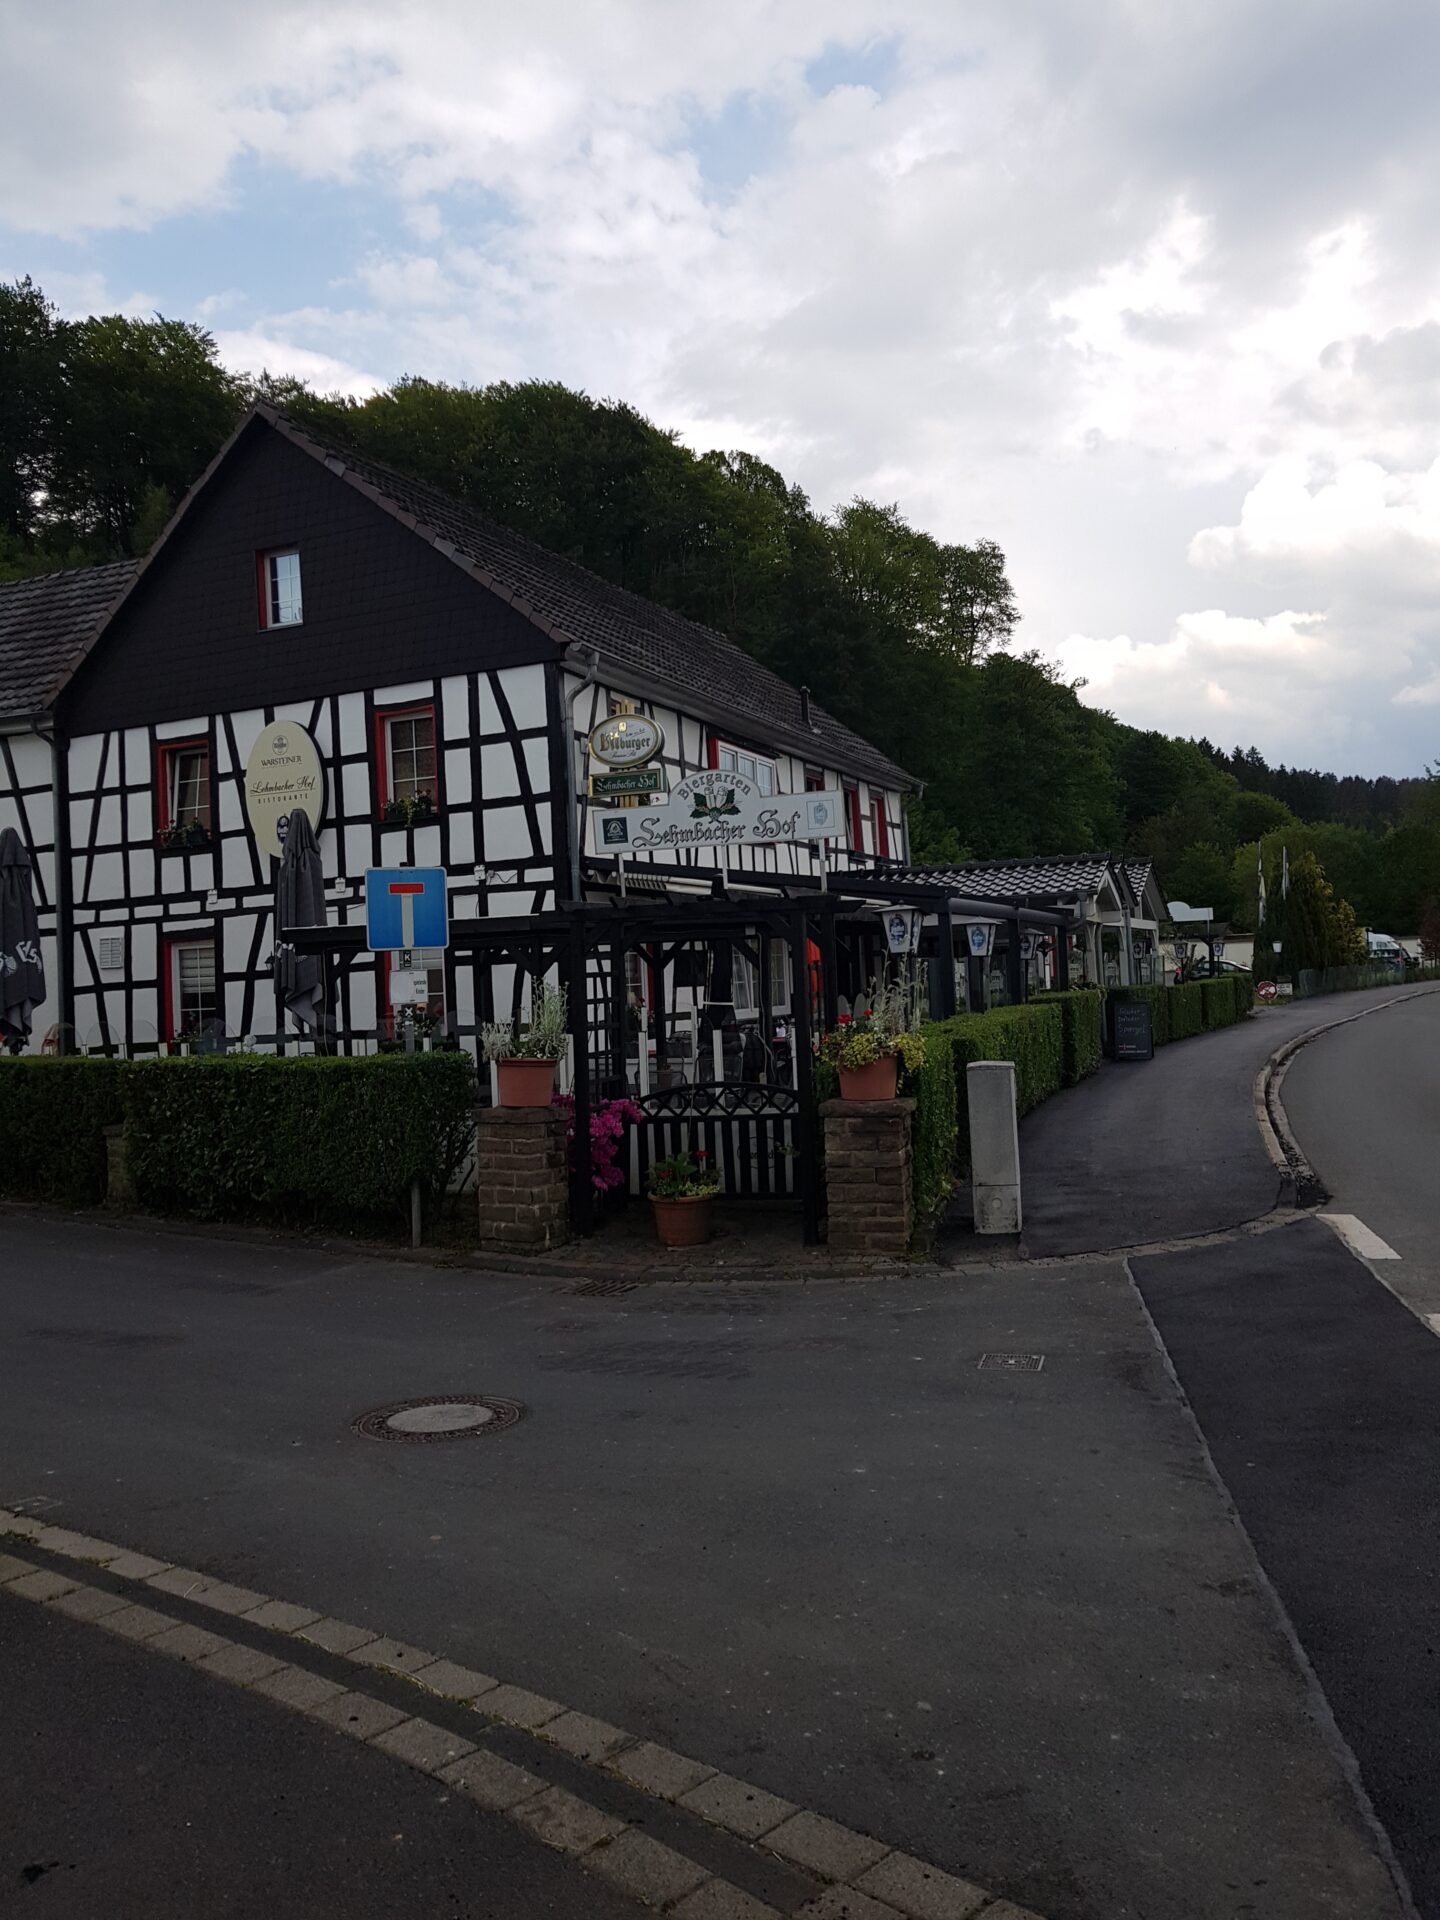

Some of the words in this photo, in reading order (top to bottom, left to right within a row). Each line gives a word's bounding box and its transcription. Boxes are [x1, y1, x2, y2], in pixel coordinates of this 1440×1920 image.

[261, 756, 302, 766] WARSTEINER
[250, 780, 294, 794] Lehmbacher
[297, 776, 315, 790] Hof
[597, 778, 636, 792] Lehmbacher
[638, 774, 656, 788] Hof
[677, 772, 752, 800] Biergarten
[258, 793, 309, 804] RISTORANTE
[632, 816, 746, 848] Lehmbacher
[752, 808, 801, 839] Hof
